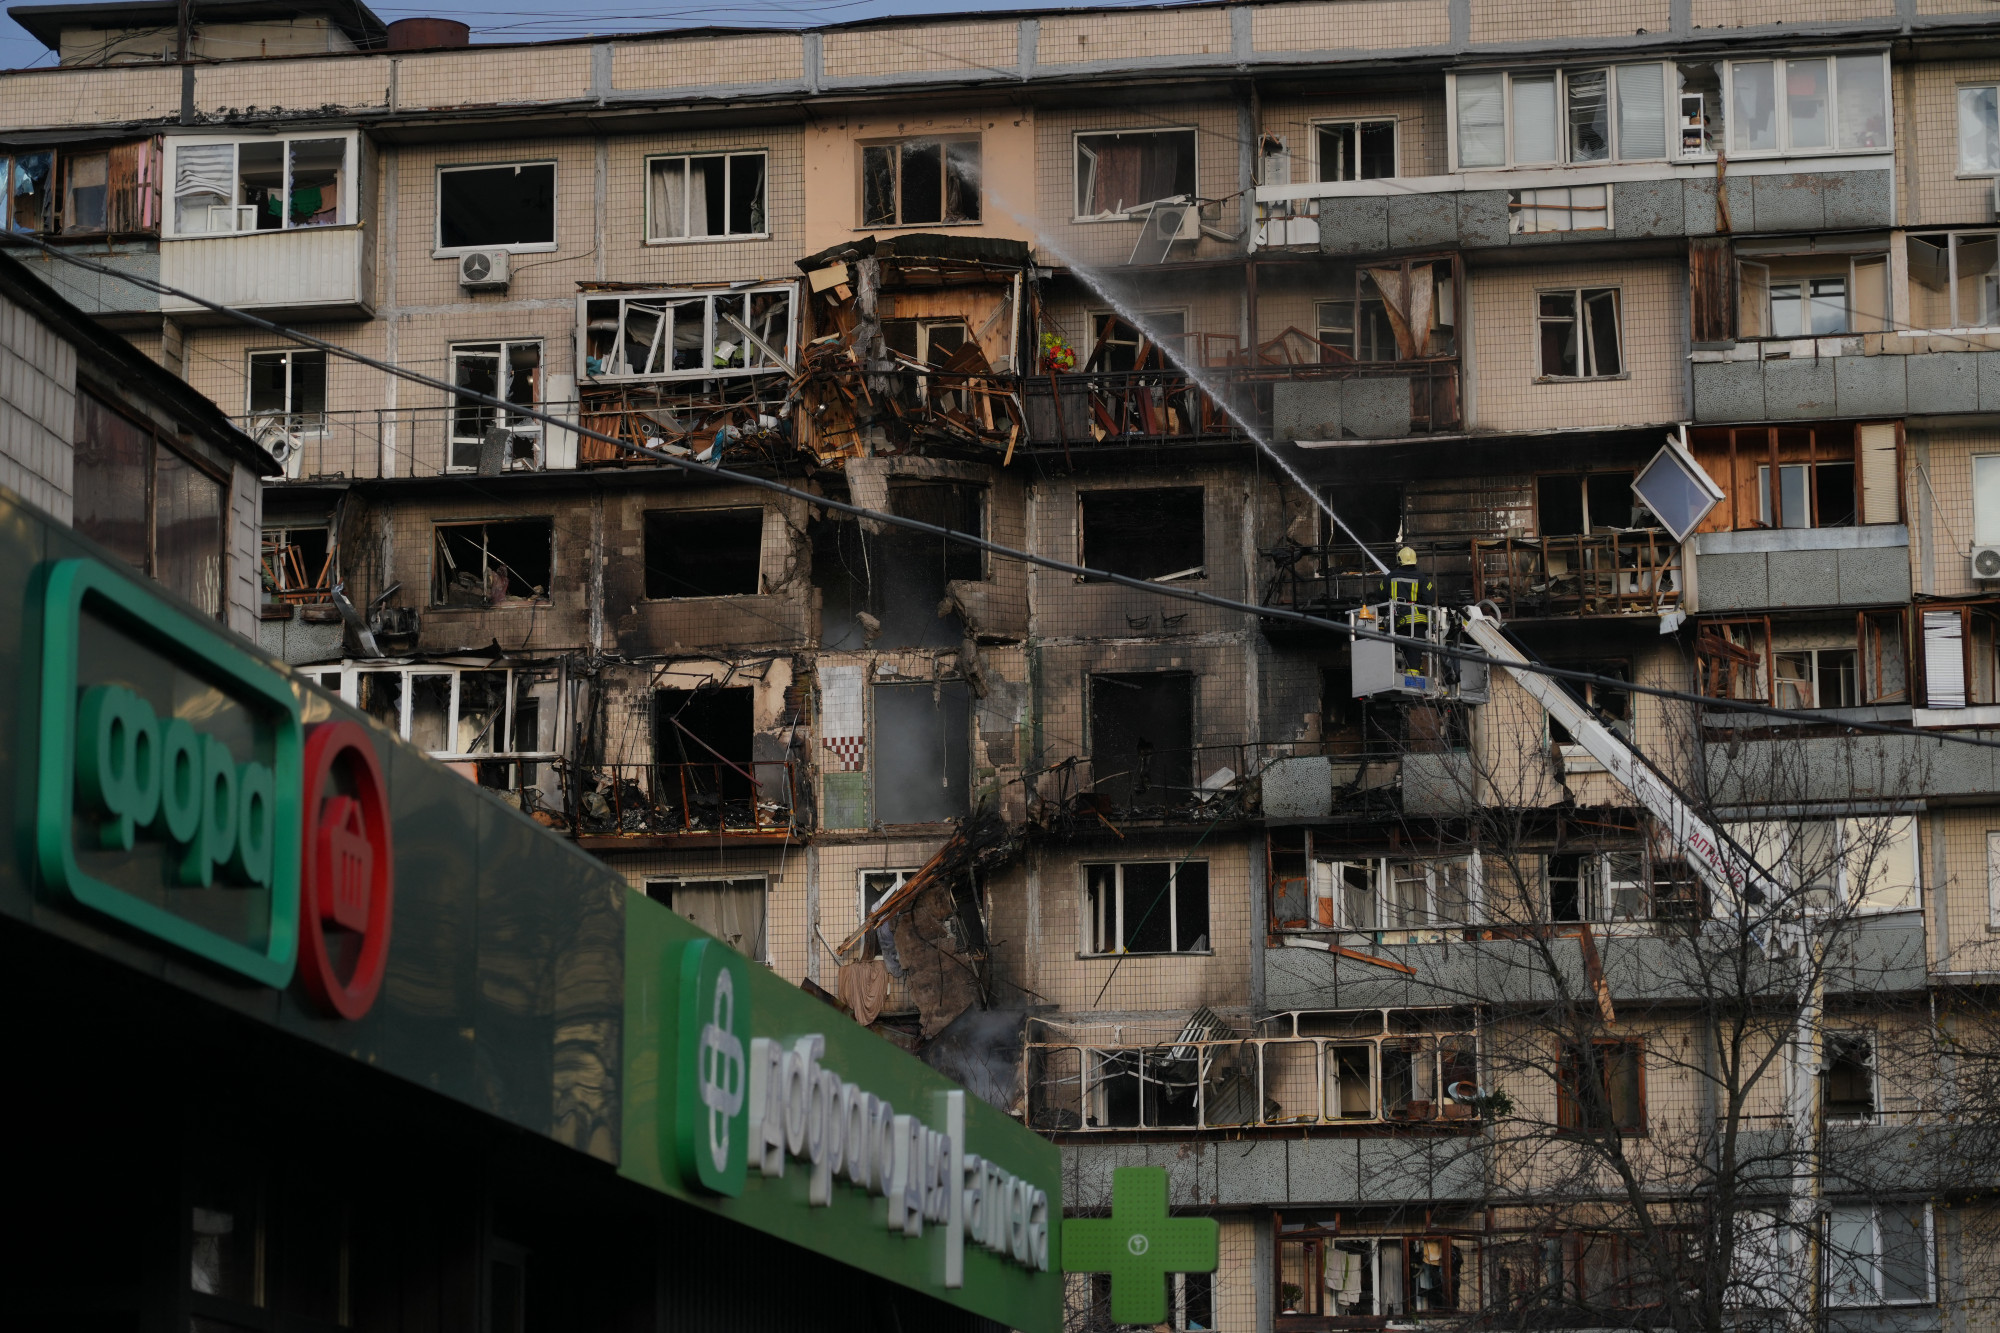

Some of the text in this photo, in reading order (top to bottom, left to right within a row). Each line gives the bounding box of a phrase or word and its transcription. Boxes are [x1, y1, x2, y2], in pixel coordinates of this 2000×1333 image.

[79, 683, 274, 890] фора
[748, 1033, 896, 1208] доброго
[963, 1153, 1049, 1273] аптека
